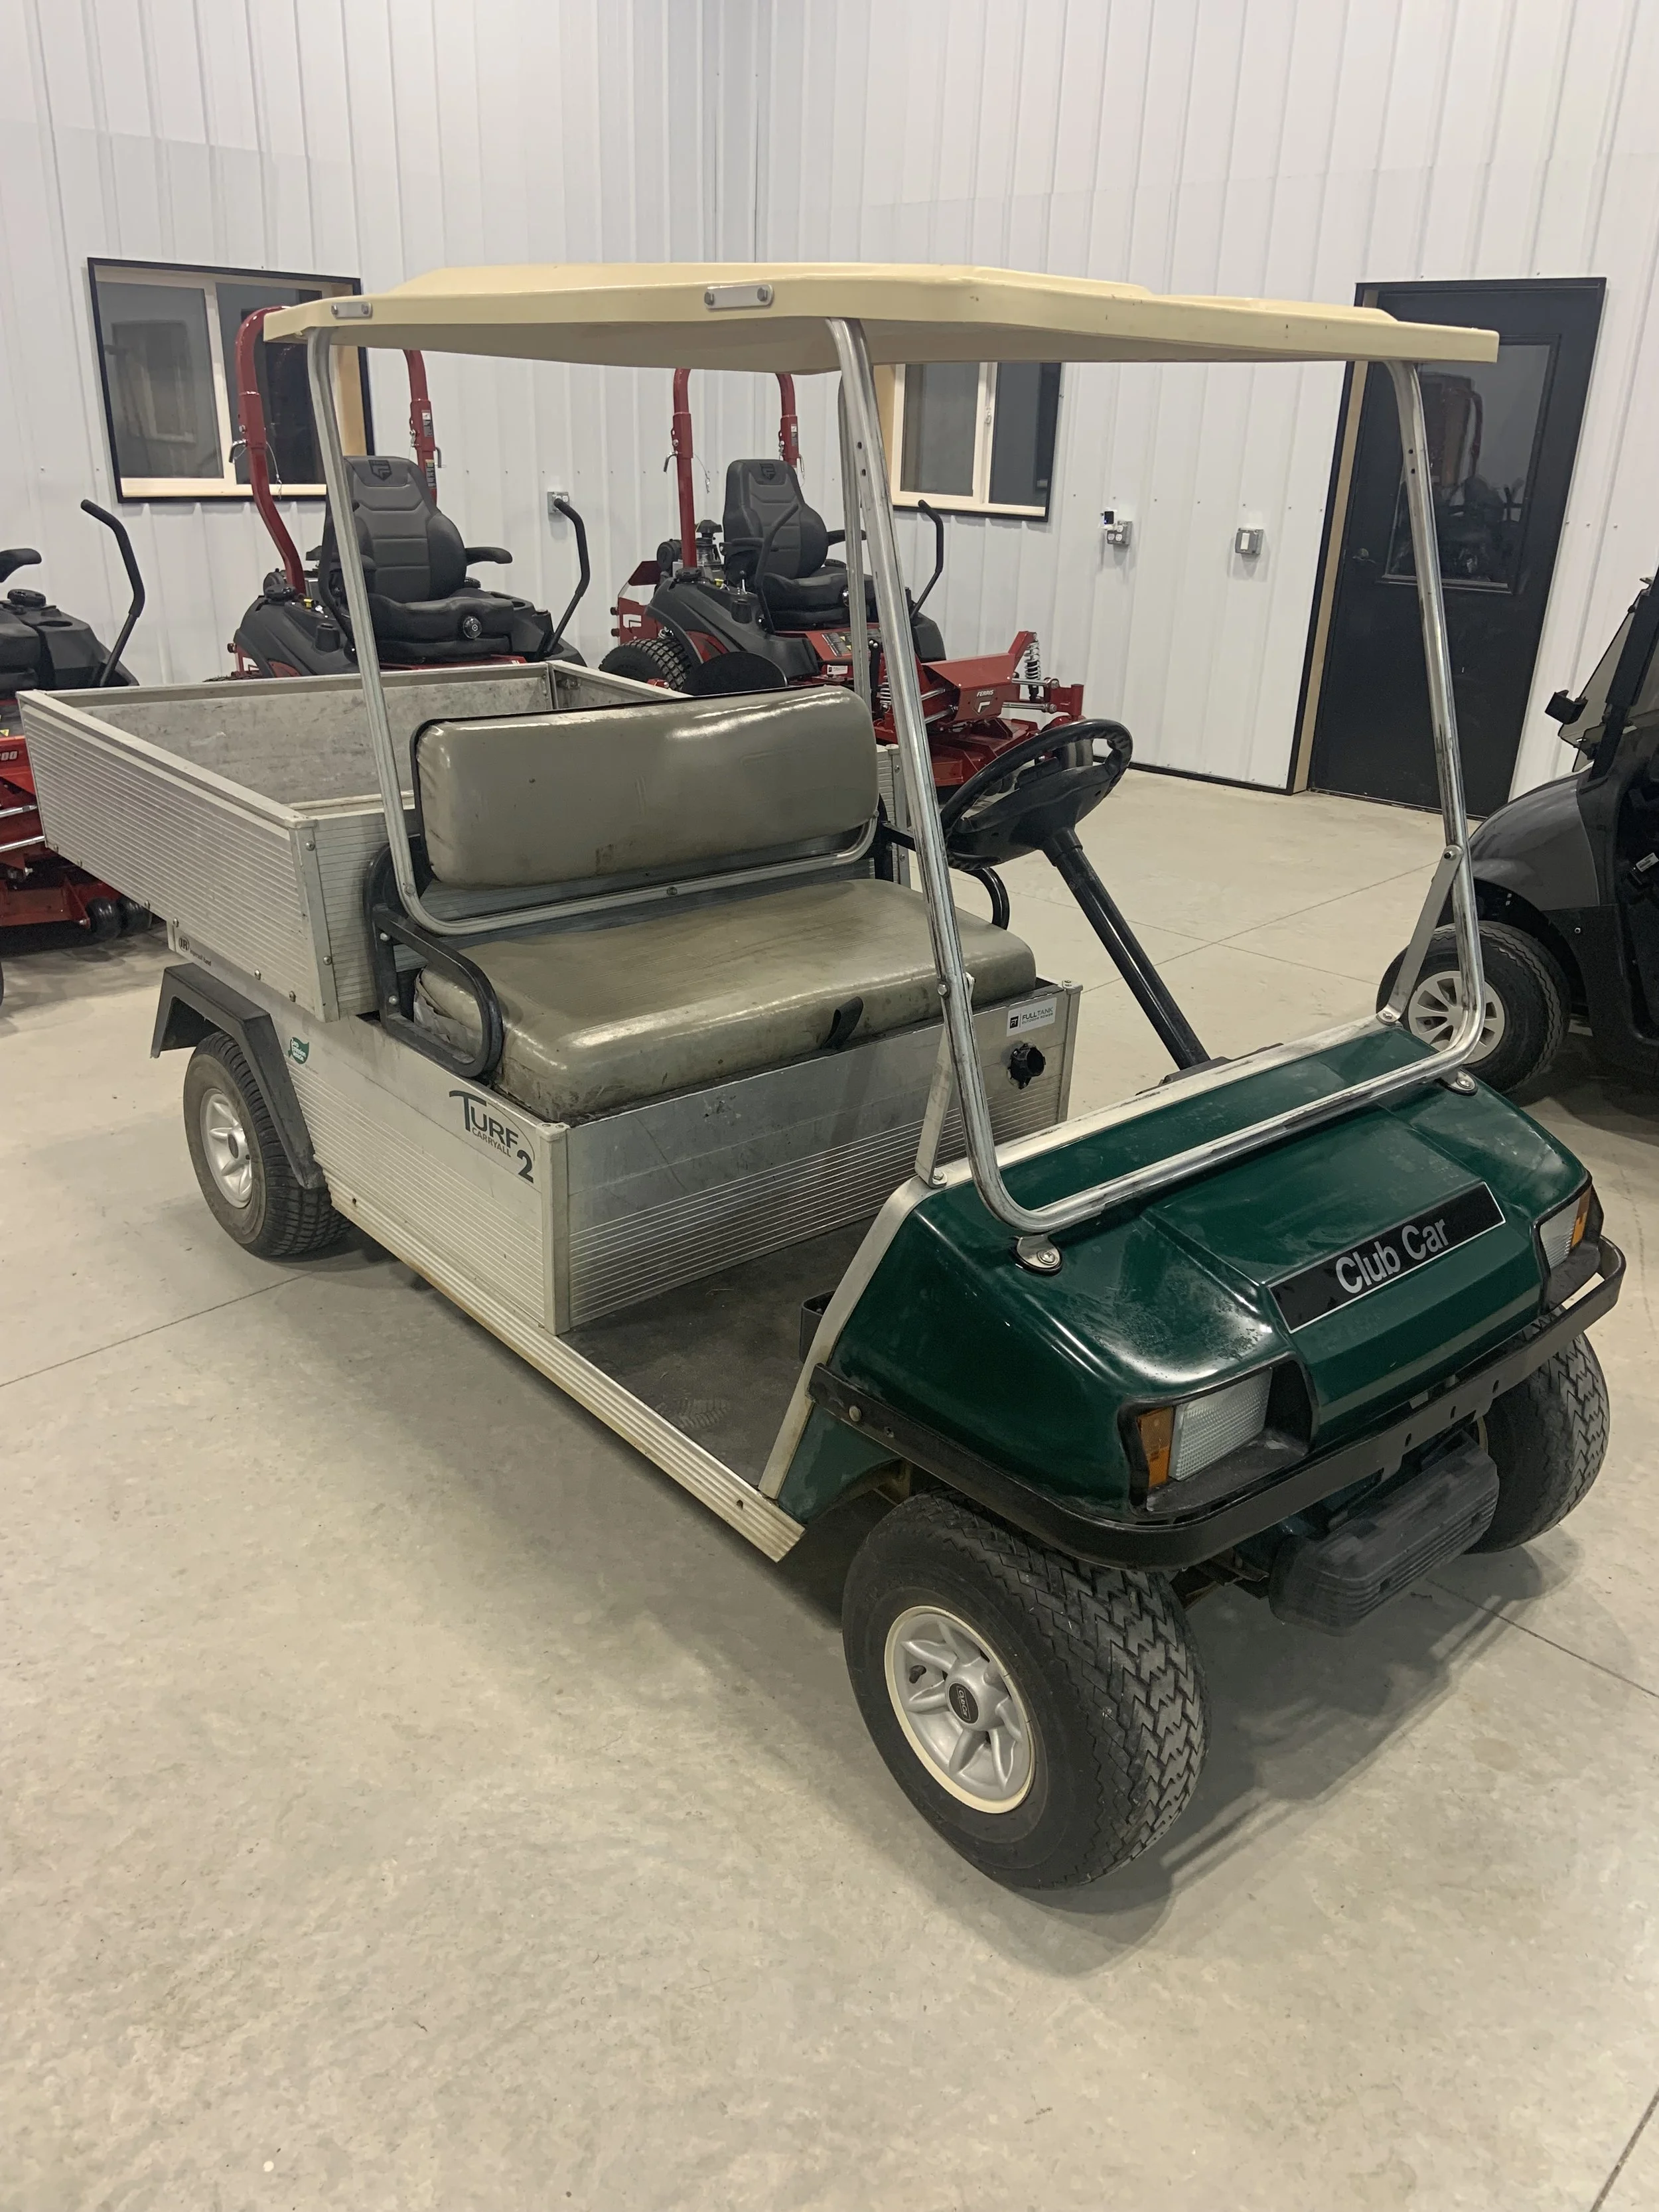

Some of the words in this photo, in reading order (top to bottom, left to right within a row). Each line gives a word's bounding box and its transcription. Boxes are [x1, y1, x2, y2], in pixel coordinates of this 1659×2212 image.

[0, 751, 18, 761] 00
[449, 1090, 518, 1149] TURF
[472, 1128, 511, 1157] CARRYALL
[517, 1149, 534, 1183] 2
[1336, 1241, 1401, 1294] Club
[1402, 1218, 1449, 1260] Car
